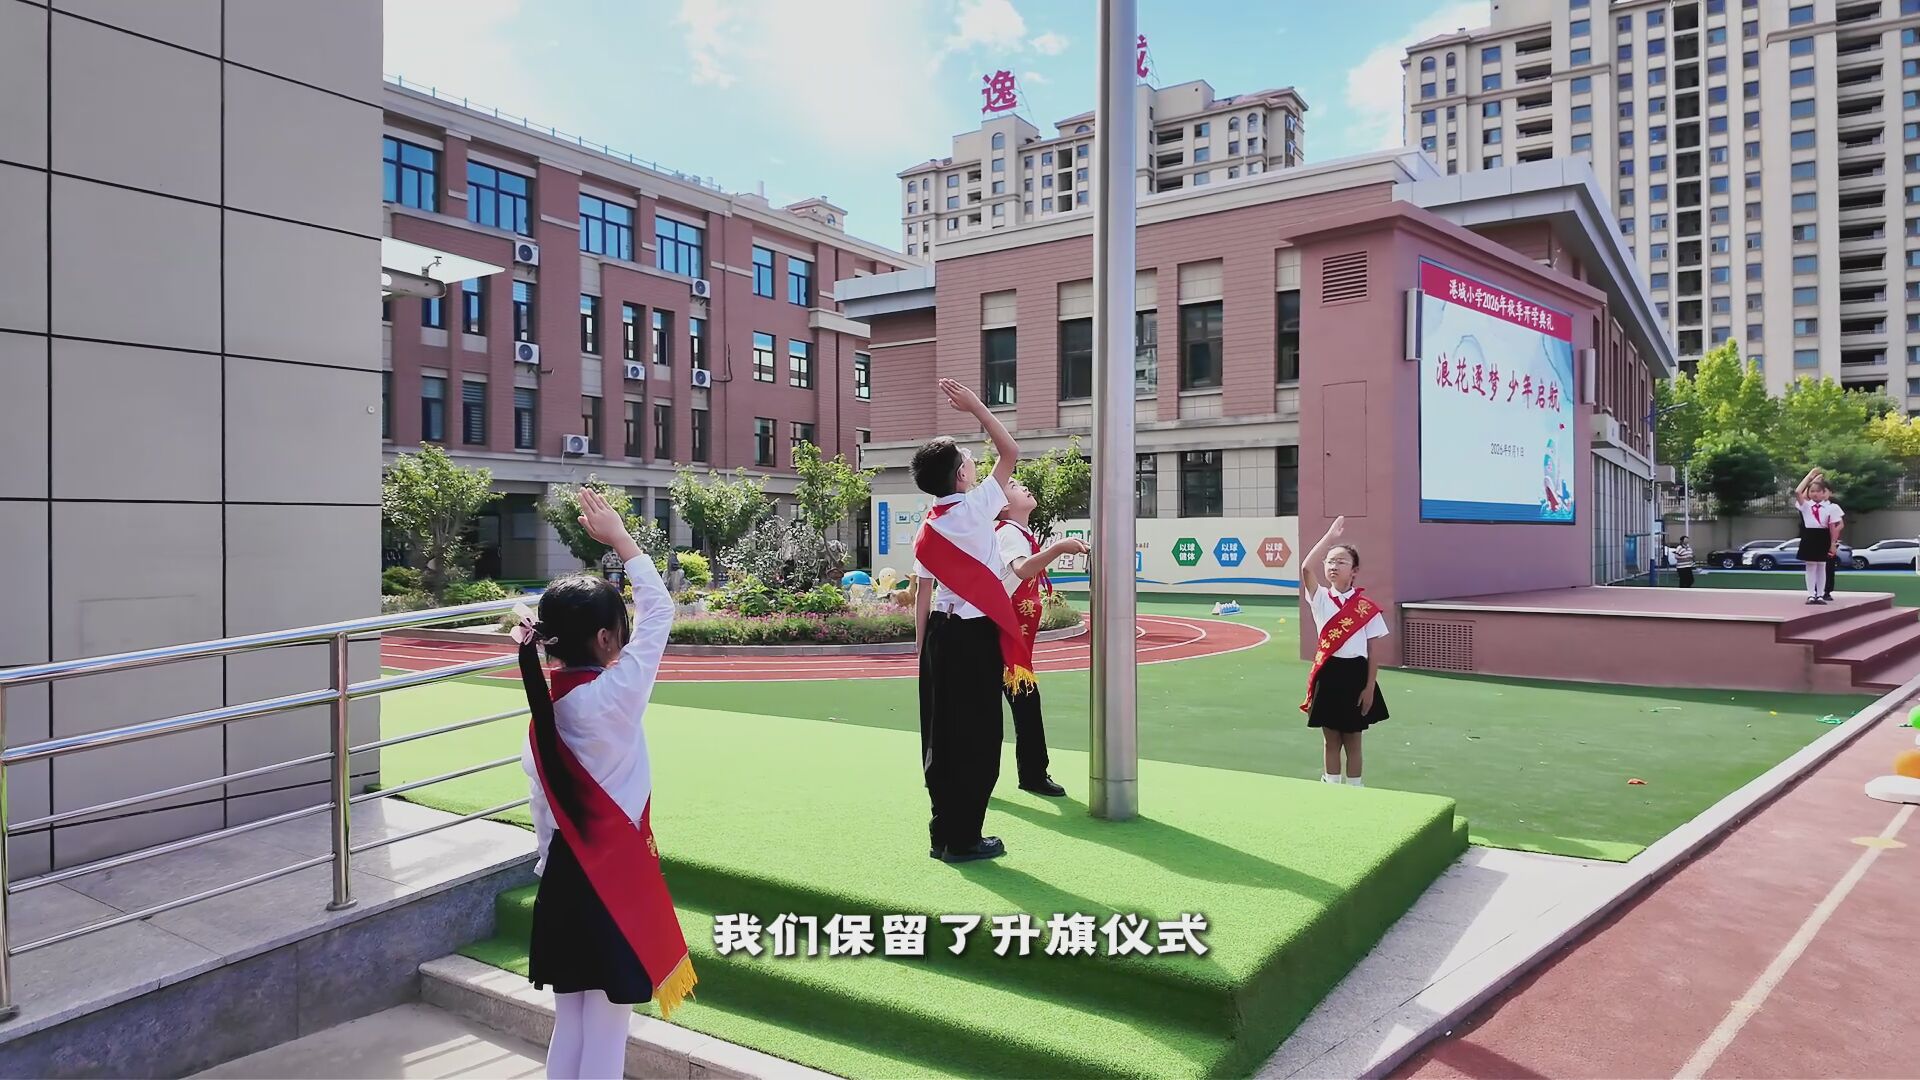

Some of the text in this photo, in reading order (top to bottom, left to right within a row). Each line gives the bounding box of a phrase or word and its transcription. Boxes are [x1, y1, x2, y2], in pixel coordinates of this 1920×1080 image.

[981, 70, 1018, 114] 逸
[1436, 352, 1560, 413] 浪花逐梦 少年启航
